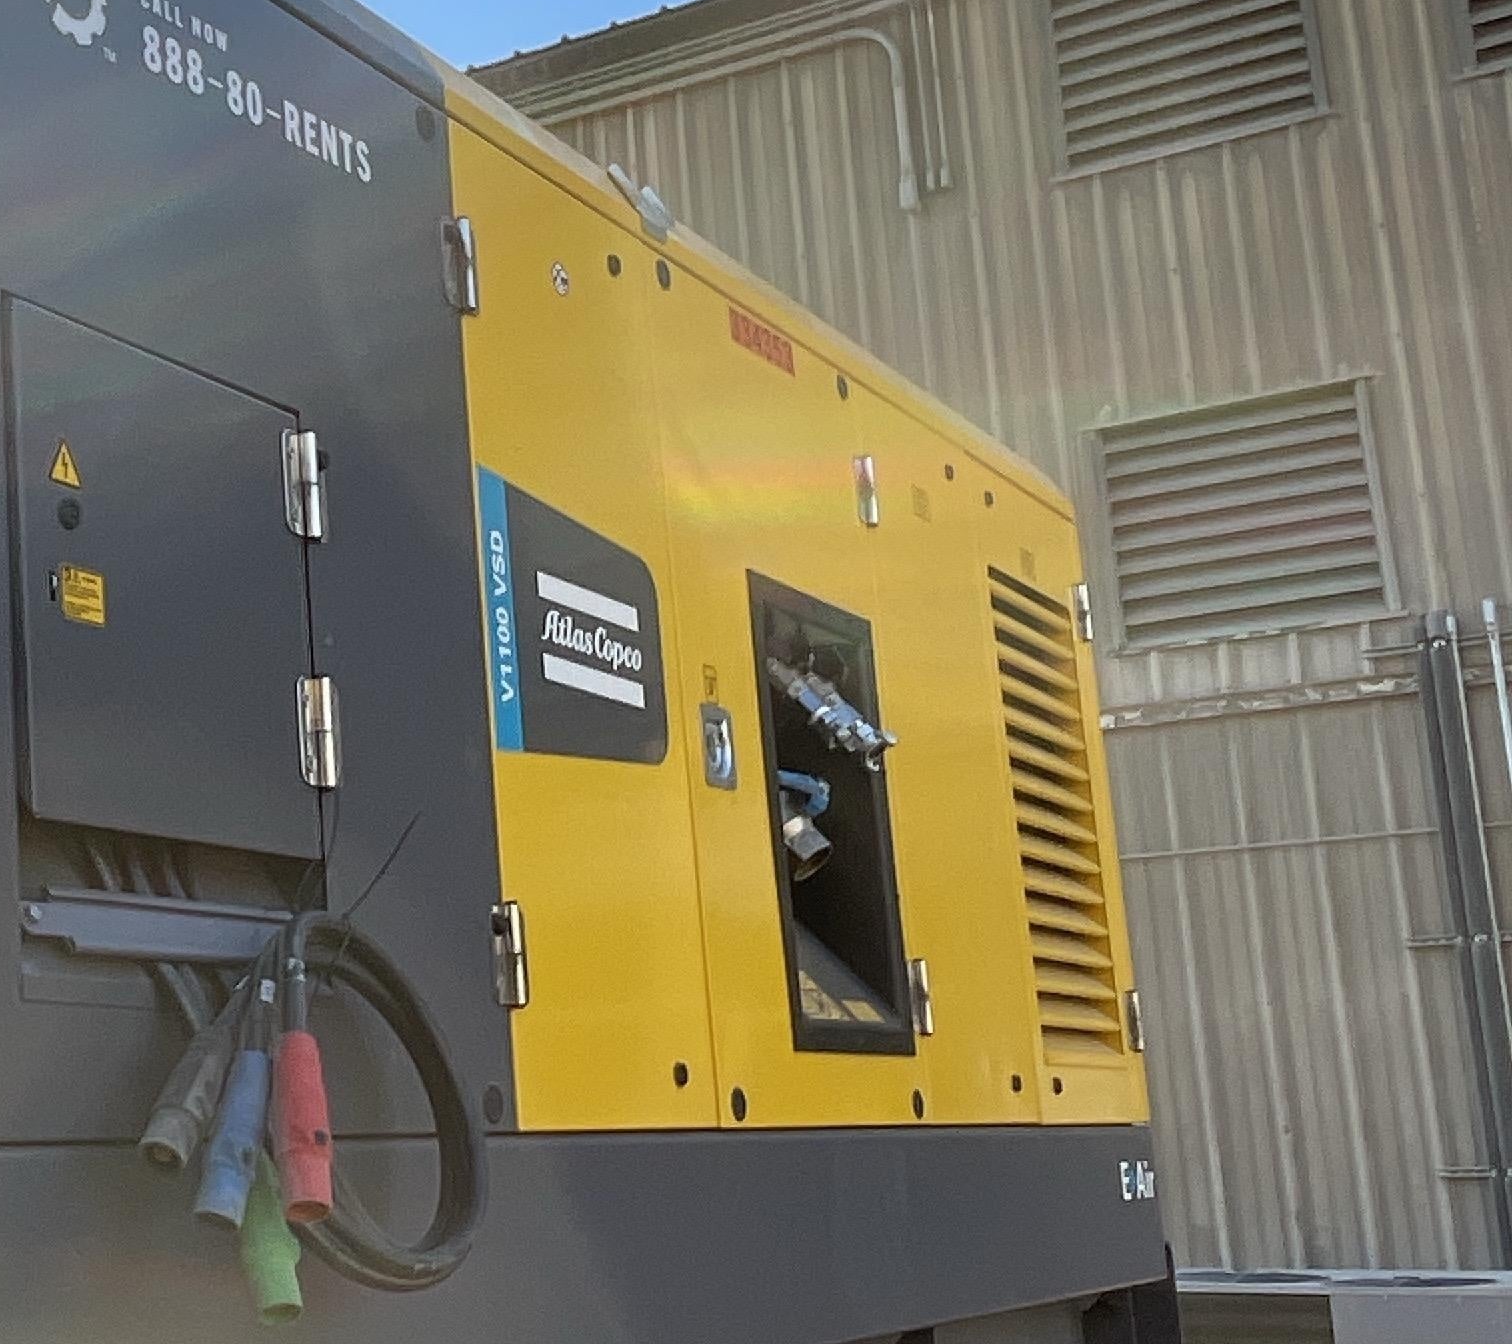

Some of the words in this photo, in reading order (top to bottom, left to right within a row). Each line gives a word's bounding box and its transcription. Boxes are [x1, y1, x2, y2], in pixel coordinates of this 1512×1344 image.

[190, 15, 229, 52] NOW
[142, 24, 373, 184] 888-80-RENTS
[489, 530, 508, 596] VSD
[494, 606, 514, 702] V1100
[541, 610, 593, 656] Atlas
[593, 626, 642, 672] Copco
